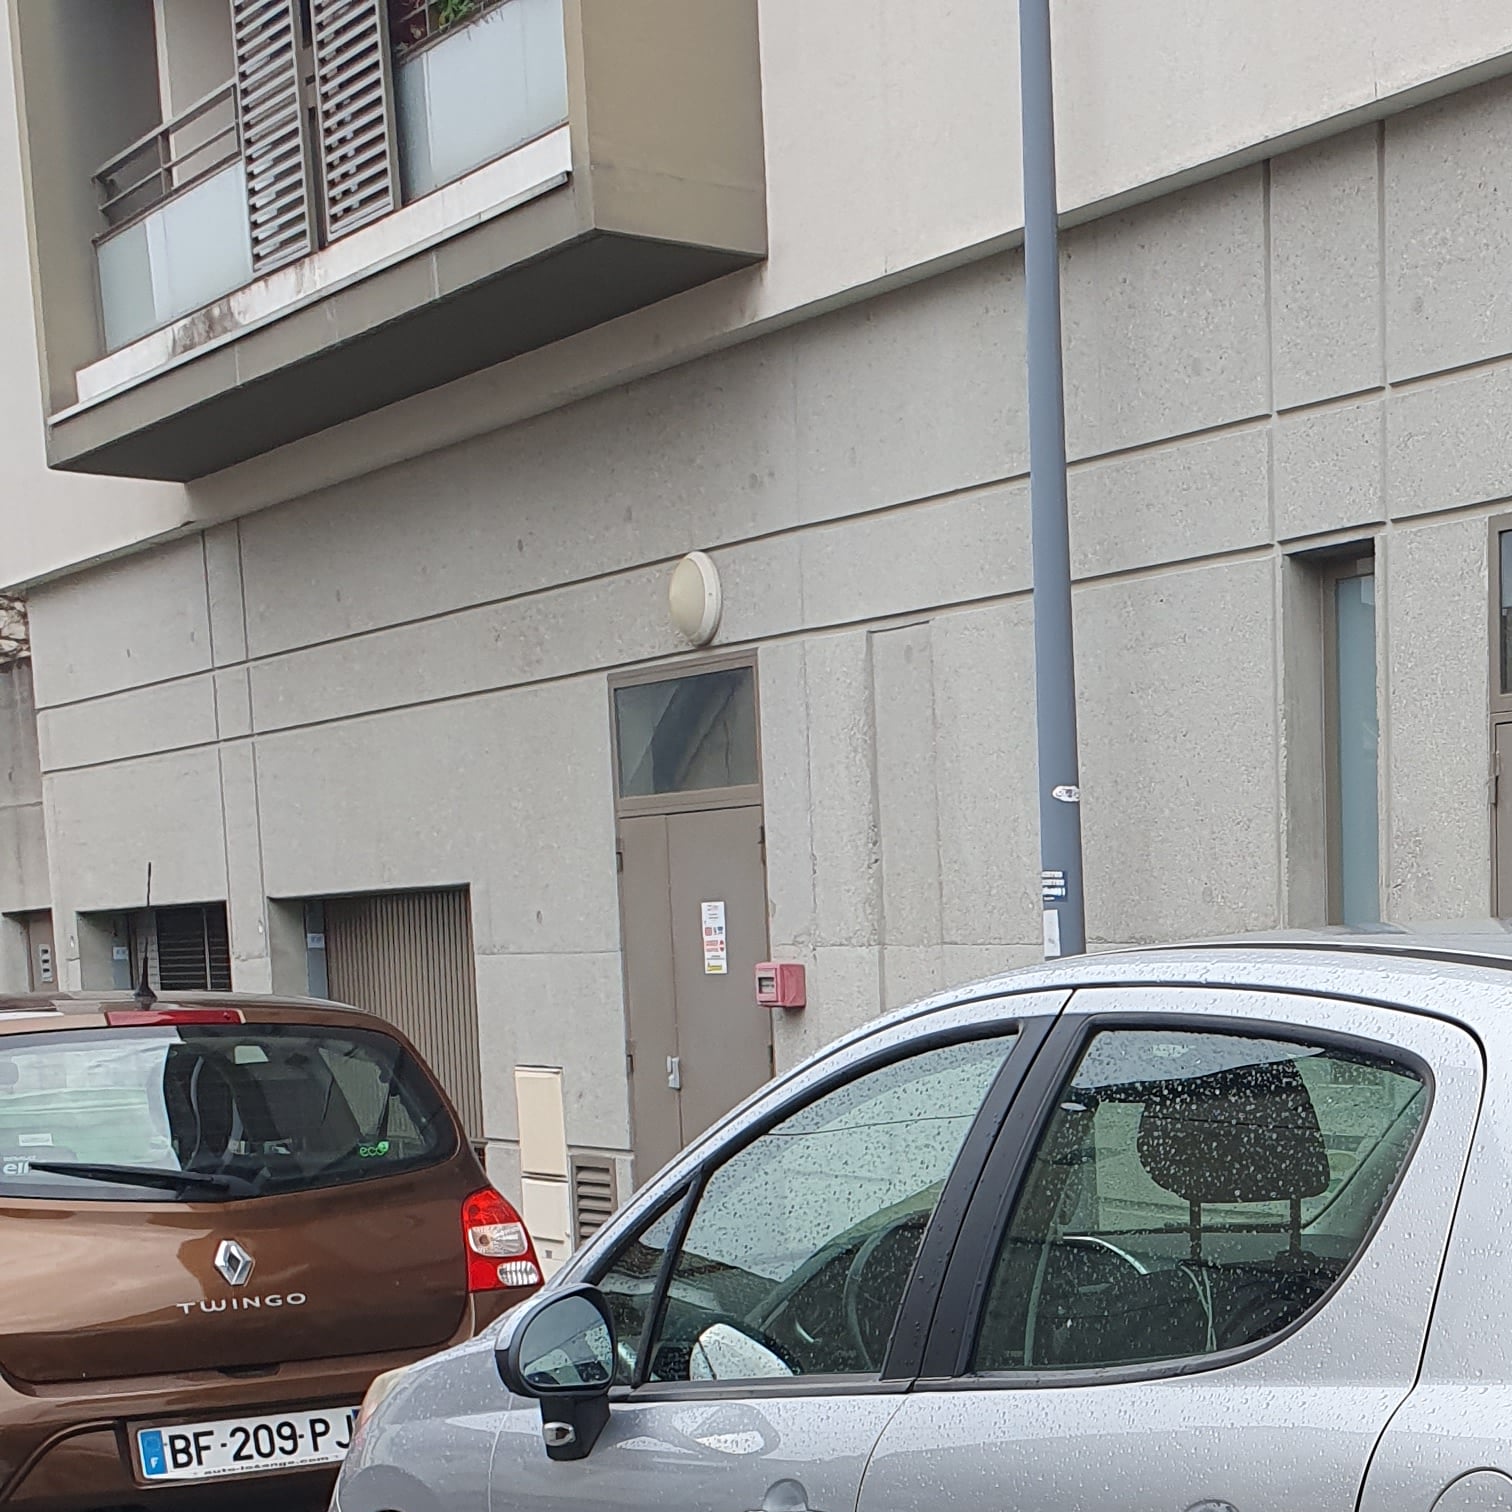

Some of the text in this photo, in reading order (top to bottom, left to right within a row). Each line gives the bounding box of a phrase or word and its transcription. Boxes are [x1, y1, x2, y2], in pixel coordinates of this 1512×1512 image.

[360, 1145, 386, 1158] eco
[175, 1292, 307, 1315] TWINGO
[150, 1457, 159, 1470] F
